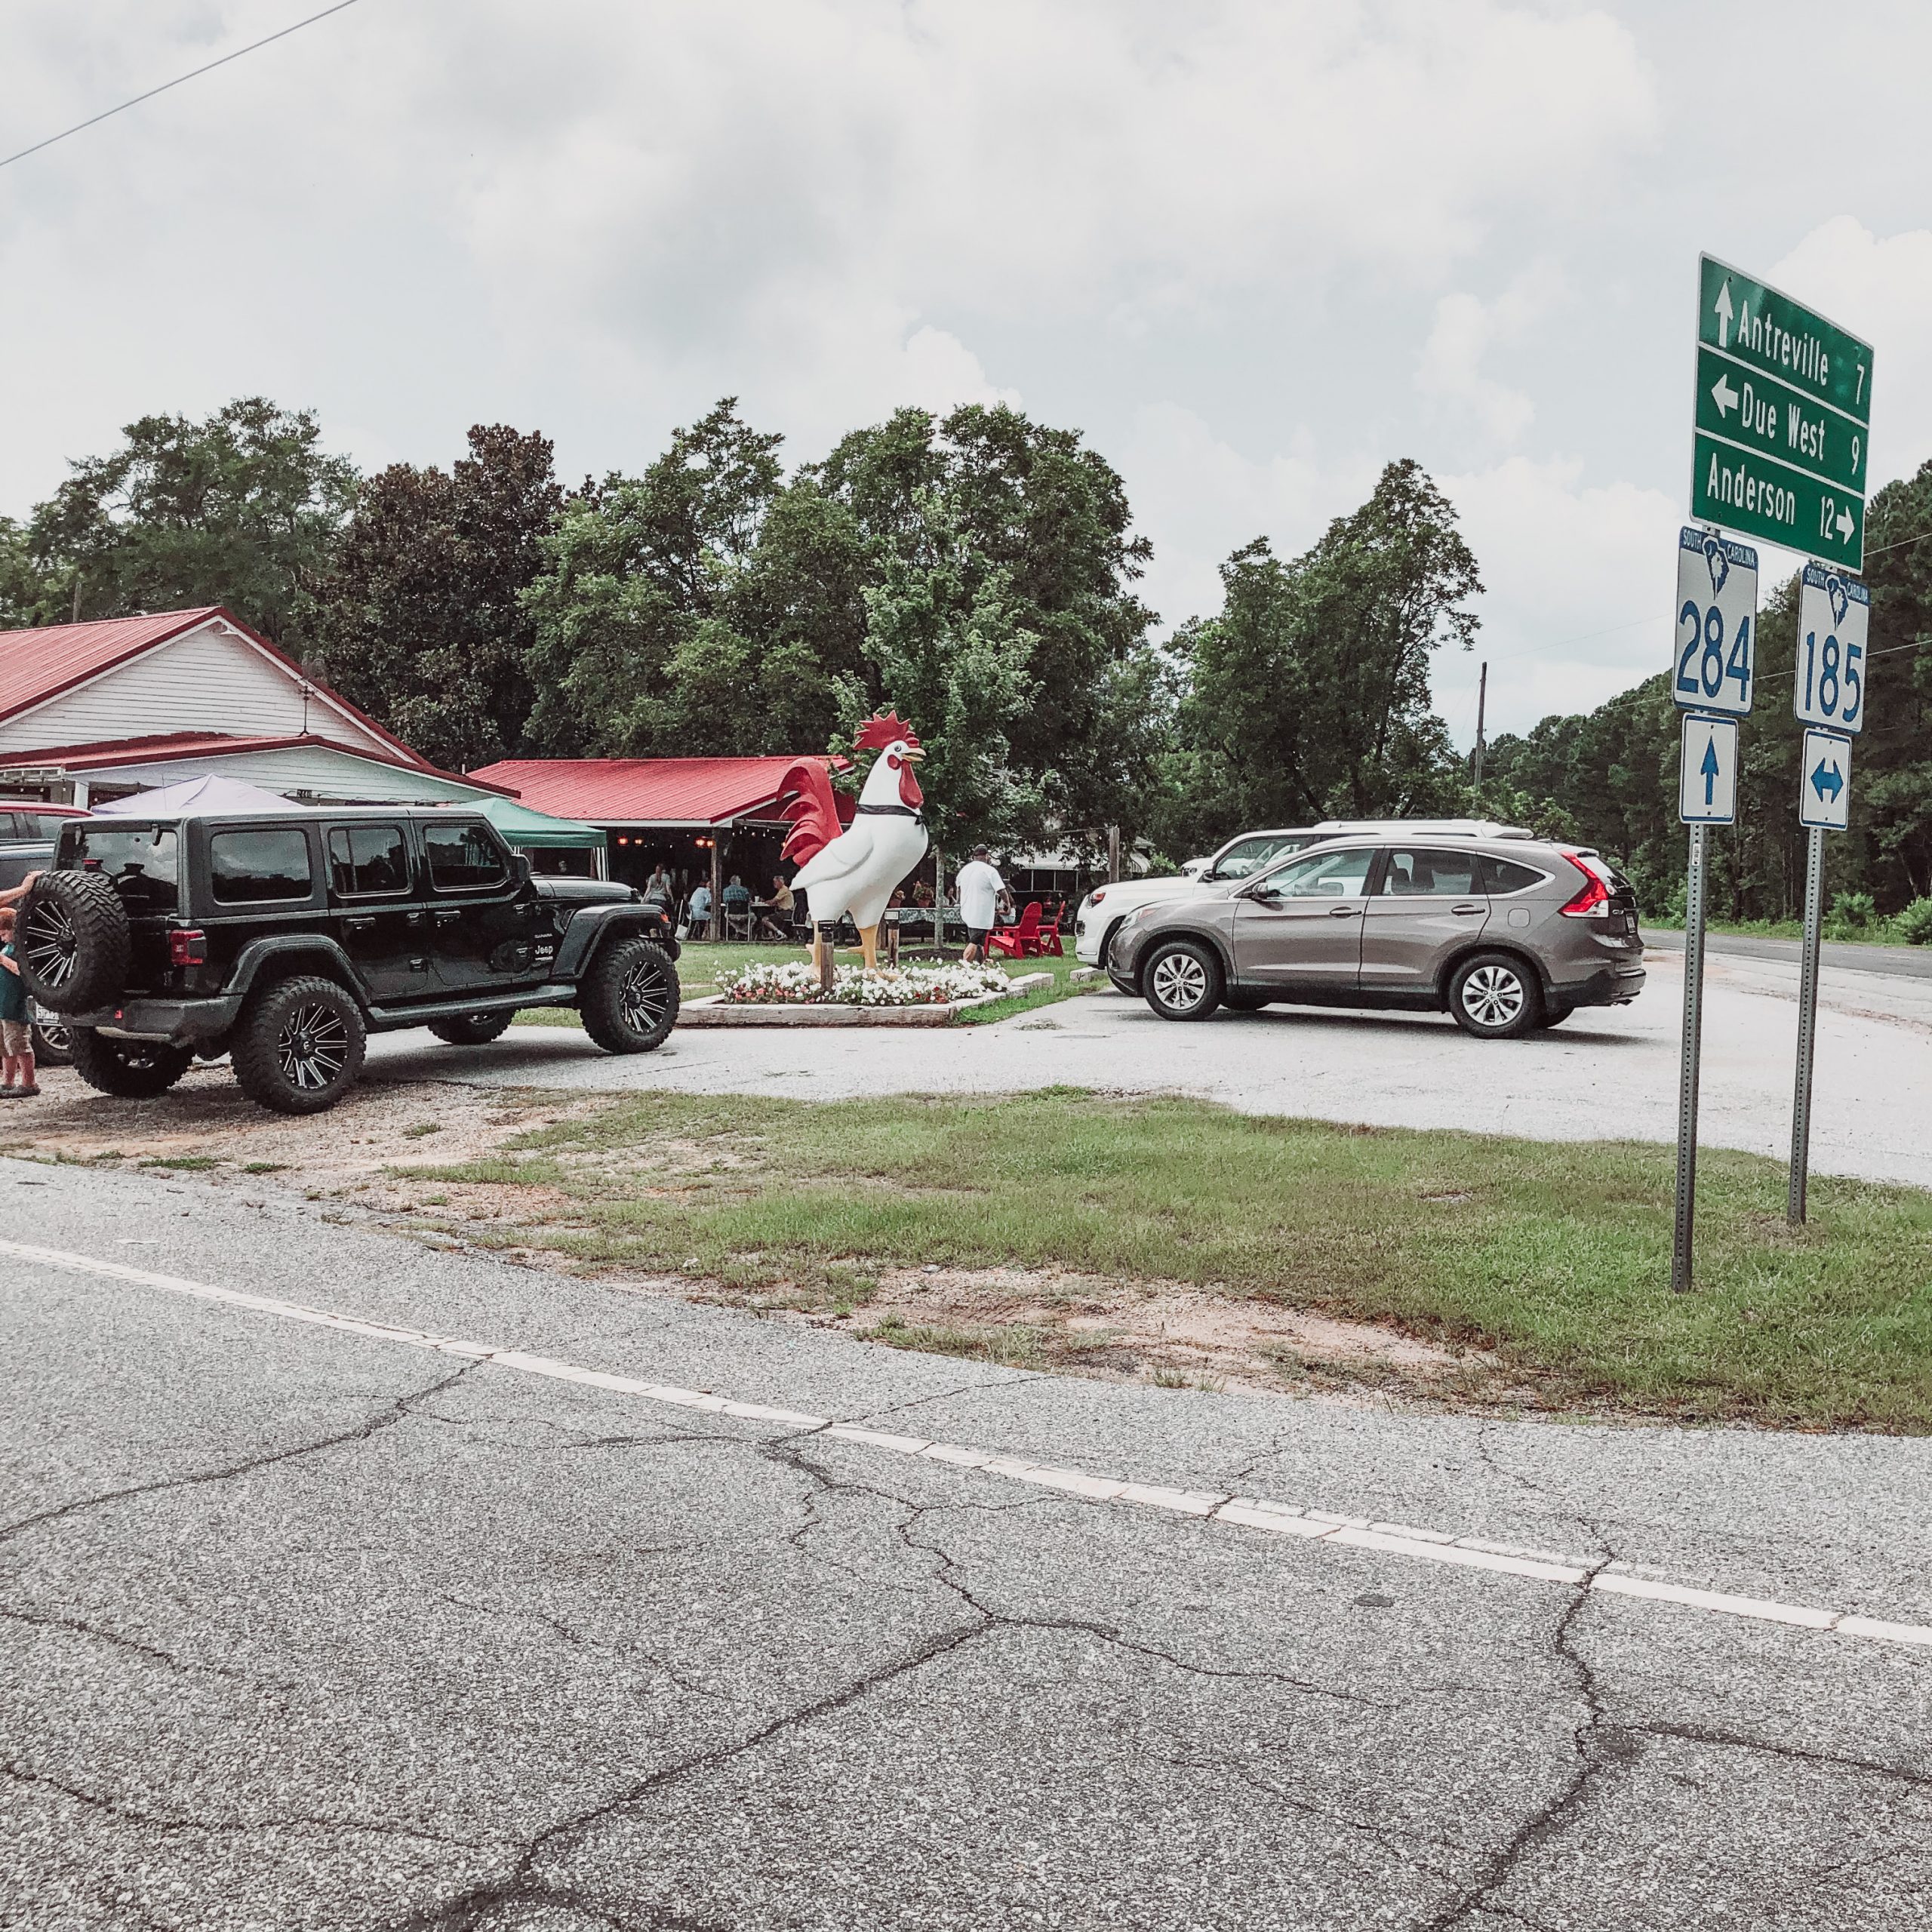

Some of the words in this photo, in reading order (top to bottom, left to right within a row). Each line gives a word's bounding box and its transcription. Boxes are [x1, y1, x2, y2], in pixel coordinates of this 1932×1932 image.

[1738, 300, 1829, 386] Antreville
[1855, 365, 1864, 405] 7
[1742, 383, 1776, 439] Due
[1788, 403, 1825, 461] West
[1851, 435, 1860, 475] 9
[1707, 452, 1795, 525] Anderson
[1820, 495, 1835, 540] 12
[1683, 529, 1702, 549] SOUTH
[1727, 543, 1755, 567] CAROLINA
[1807, 568, 1825, 586] SOUTH
[1676, 600, 1749, 702] 284
[1805, 631, 1863, 722] 185
[534, 945, 553, 955] Jeep
